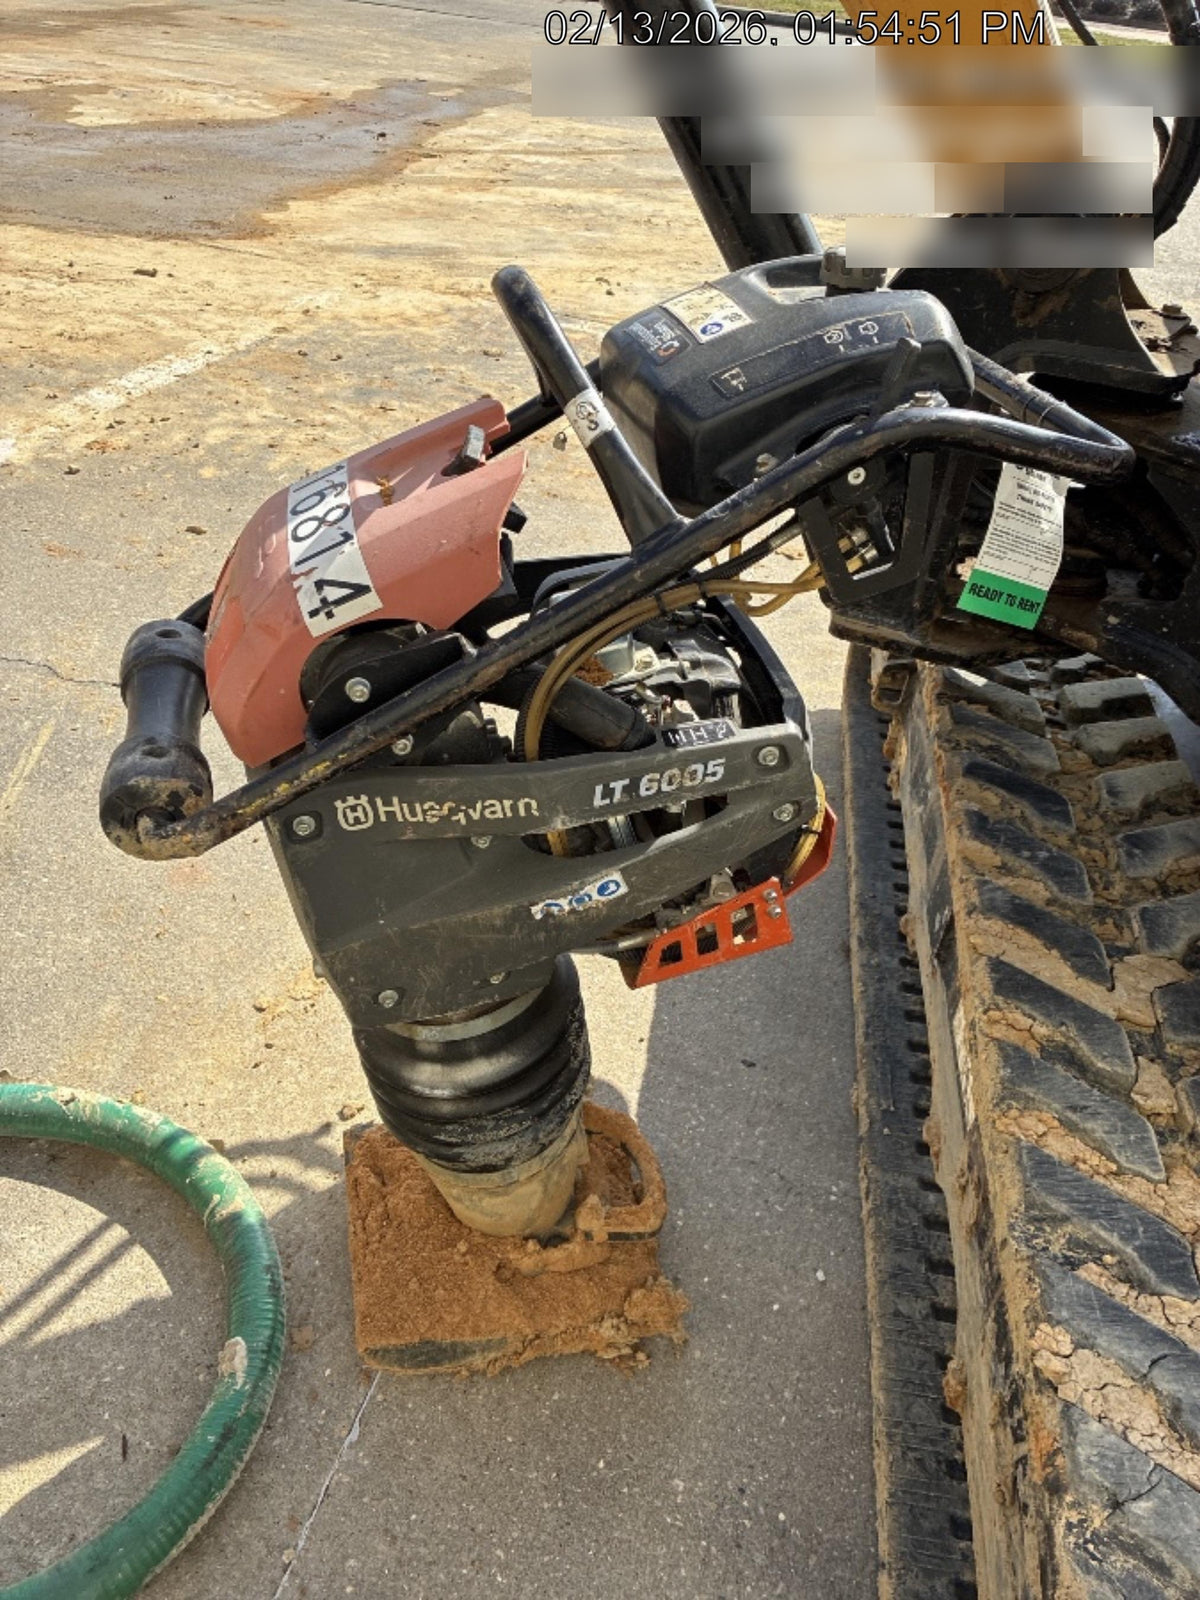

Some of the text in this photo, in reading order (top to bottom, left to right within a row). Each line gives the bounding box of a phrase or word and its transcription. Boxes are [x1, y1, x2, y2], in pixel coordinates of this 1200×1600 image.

[289, 464, 373, 620] 16814
[968, 582, 1042, 614] READY TO RENT
[593, 758, 726, 808] LT 6005
